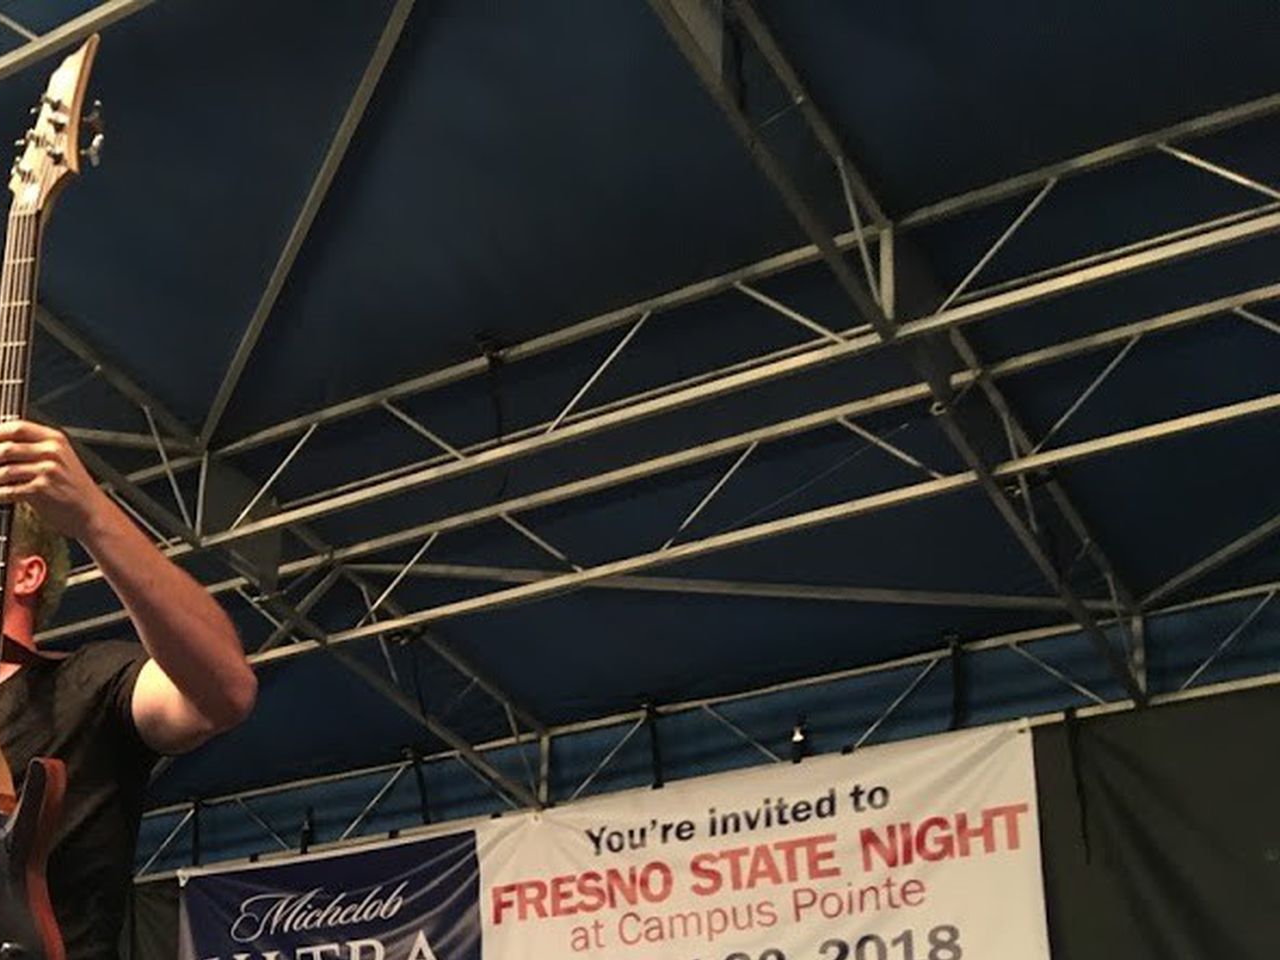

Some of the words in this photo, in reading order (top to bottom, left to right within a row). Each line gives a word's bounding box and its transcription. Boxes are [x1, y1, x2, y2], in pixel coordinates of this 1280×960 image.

[586, 819, 695, 856] You're
[708, 788, 837, 837] invited
[849, 784, 890, 813] to
[491, 860, 675, 925] FRESNO
[689, 833, 841, 896] STATE
[859, 803, 1028, 872] NIGHT
[230, 881, 409, 943] Michelob
[571, 920, 605, 951] at
[618, 900, 778, 945] Campus
[792, 876, 926, 923] Pointe
